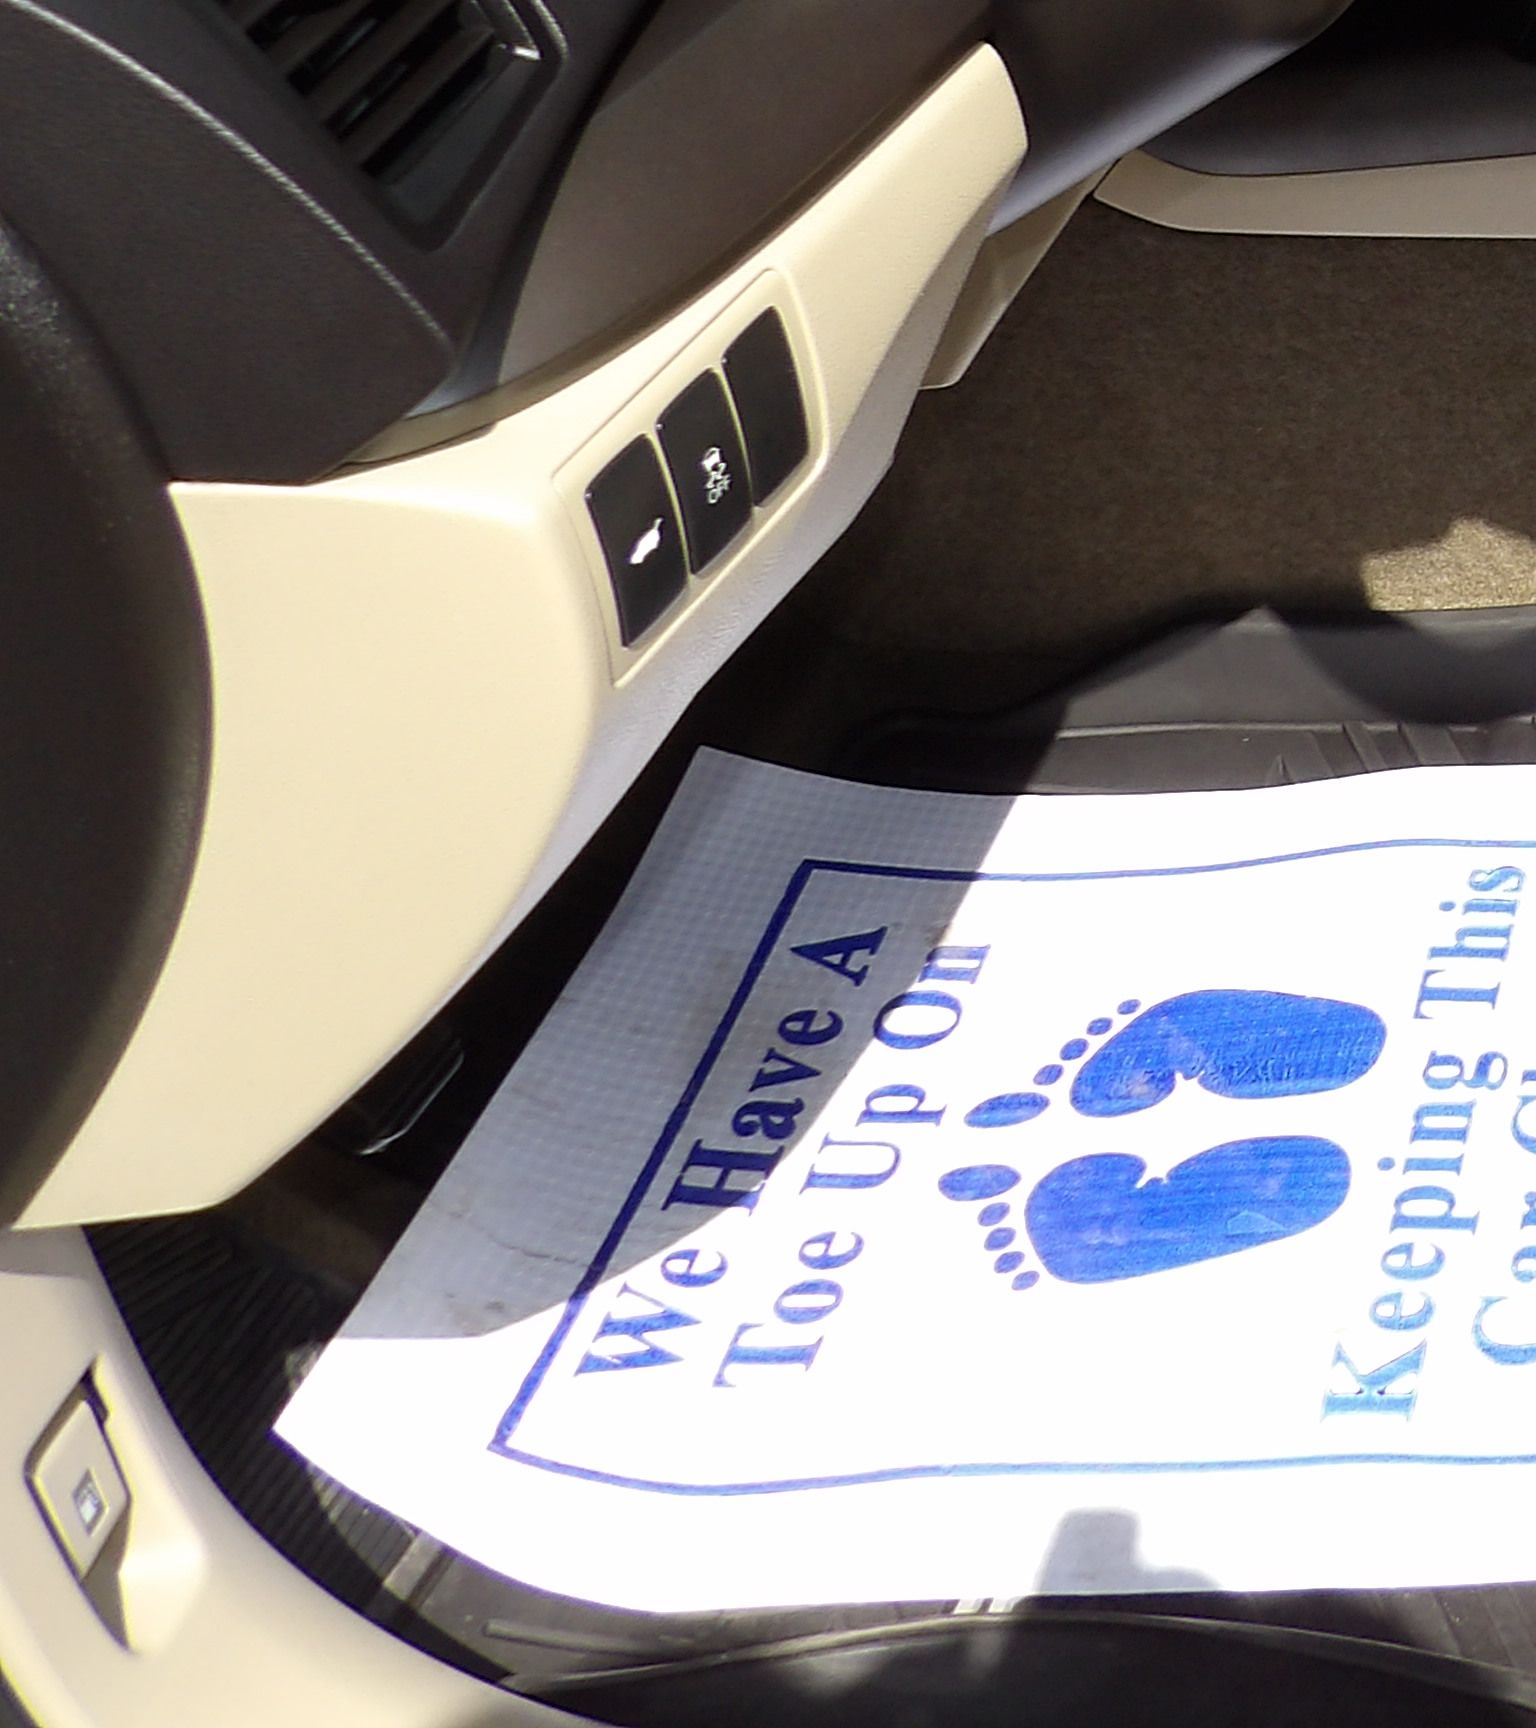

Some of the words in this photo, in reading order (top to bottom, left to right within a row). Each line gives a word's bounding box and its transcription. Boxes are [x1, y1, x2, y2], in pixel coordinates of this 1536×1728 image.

[873, 943, 991, 1049] On
[1412, 865, 1526, 1020] This
[574, 1248, 729, 1377] We
[661, 1008, 844, 1216] Have
[790, 926, 888, 987] A
[799, 1083, 948, 1195] Up
[712, 1231, 865, 1388] Toe
[1320, 1050, 1509, 1422] Keeping
